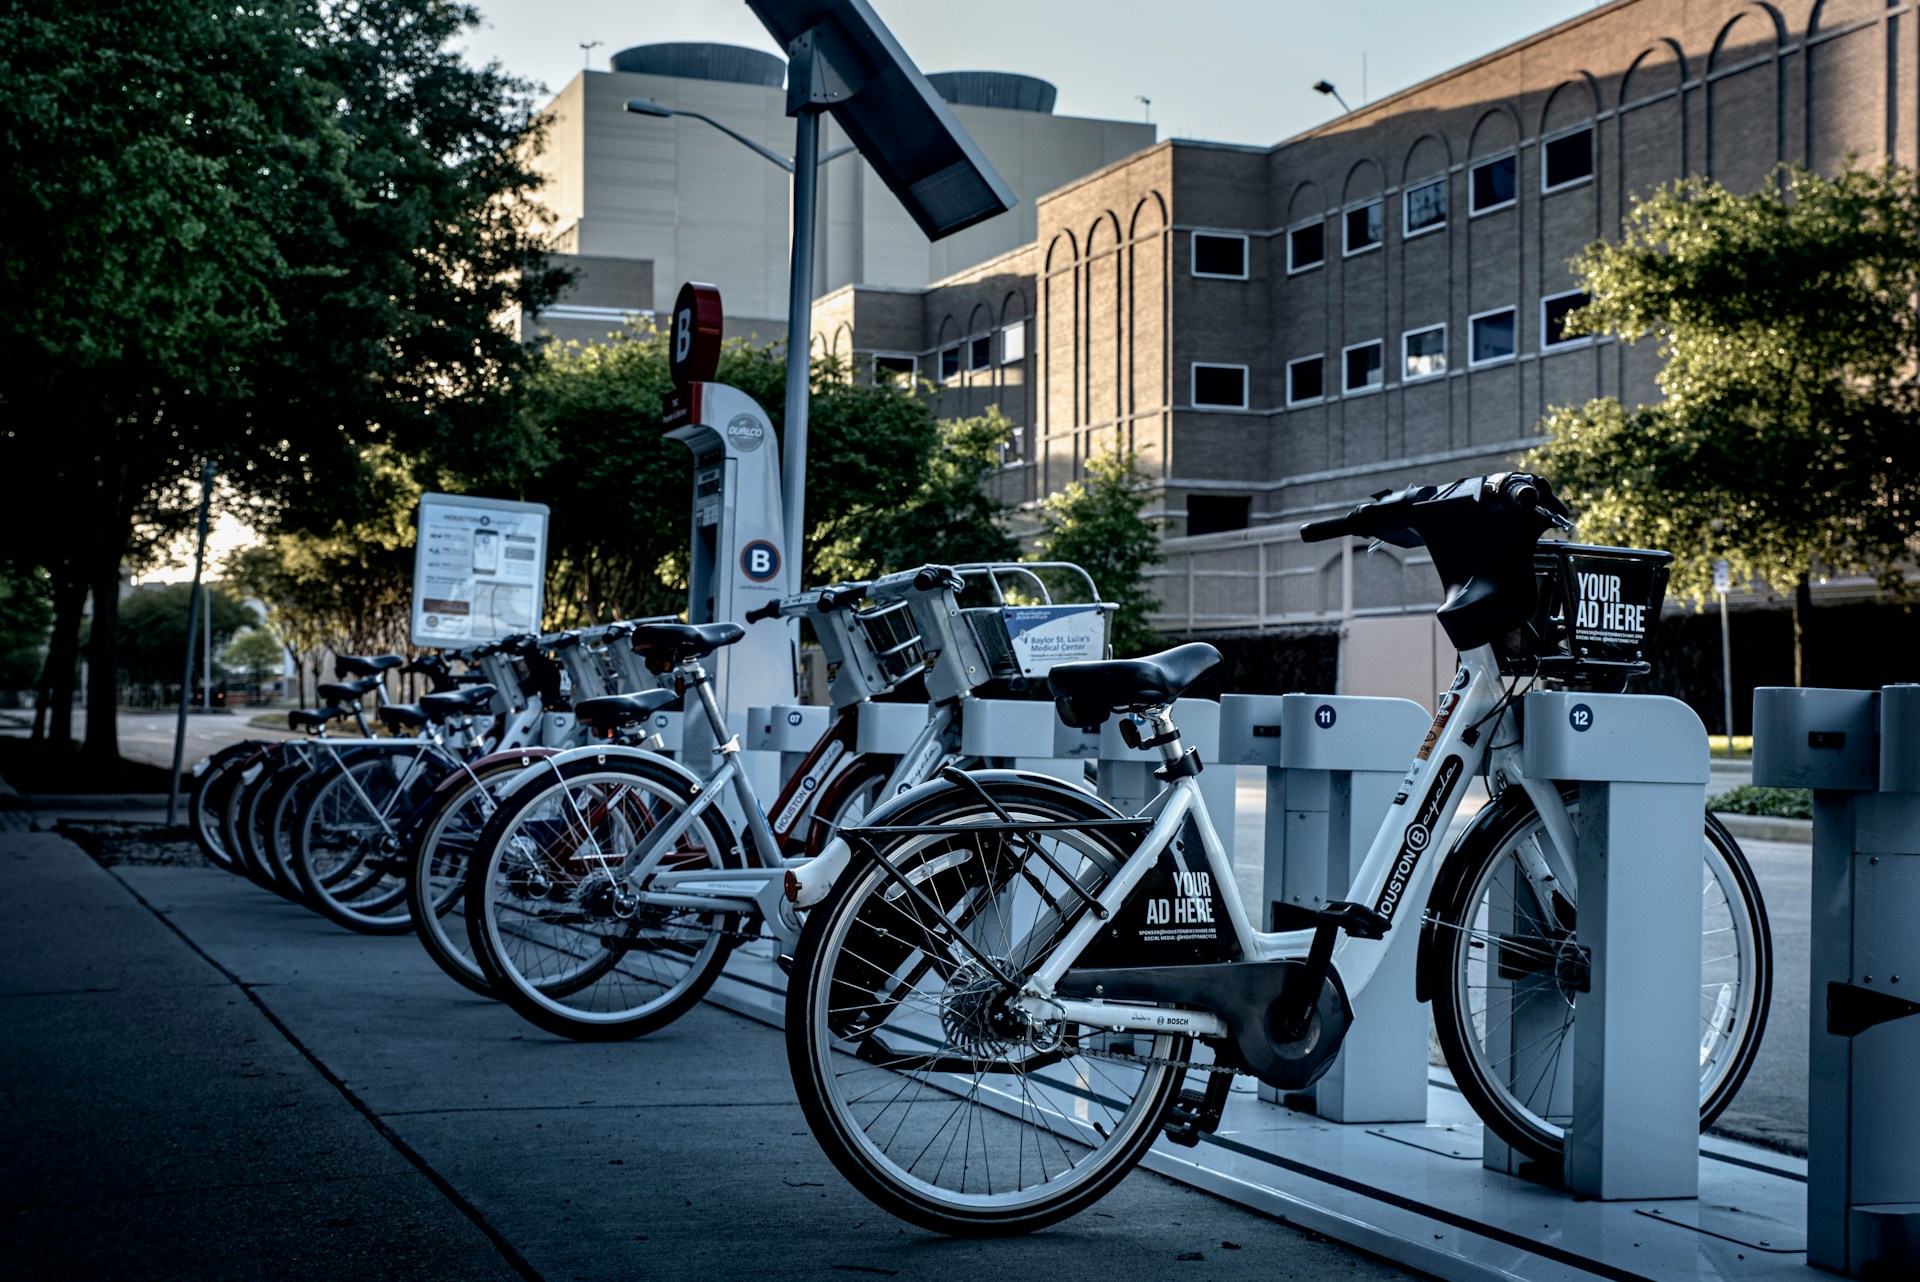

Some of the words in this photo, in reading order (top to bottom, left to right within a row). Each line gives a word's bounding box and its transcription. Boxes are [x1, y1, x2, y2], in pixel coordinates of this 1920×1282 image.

[676, 308, 691, 363] B
[751, 549, 770, 572] B
[1577, 572, 1621, 602] YOUR
[1576, 600, 1599, 629] AD
[1603, 602, 1646, 632] HERE
[1031, 636, 1054, 645] Baylor
[789, 714, 801, 722] 07
[1319, 711, 1330, 723] 11
[1573, 711, 1588, 725] 12
[777, 789, 807, 830] HOUSTON
[805, 779, 814, 788] B
[1411, 830, 1425, 845] B
[1423, 762, 1457, 825] cycle
[1173, 872, 1211, 897] YOUR
[1146, 899, 1170, 924] AD
[1175, 898, 1215, 923] HERE
